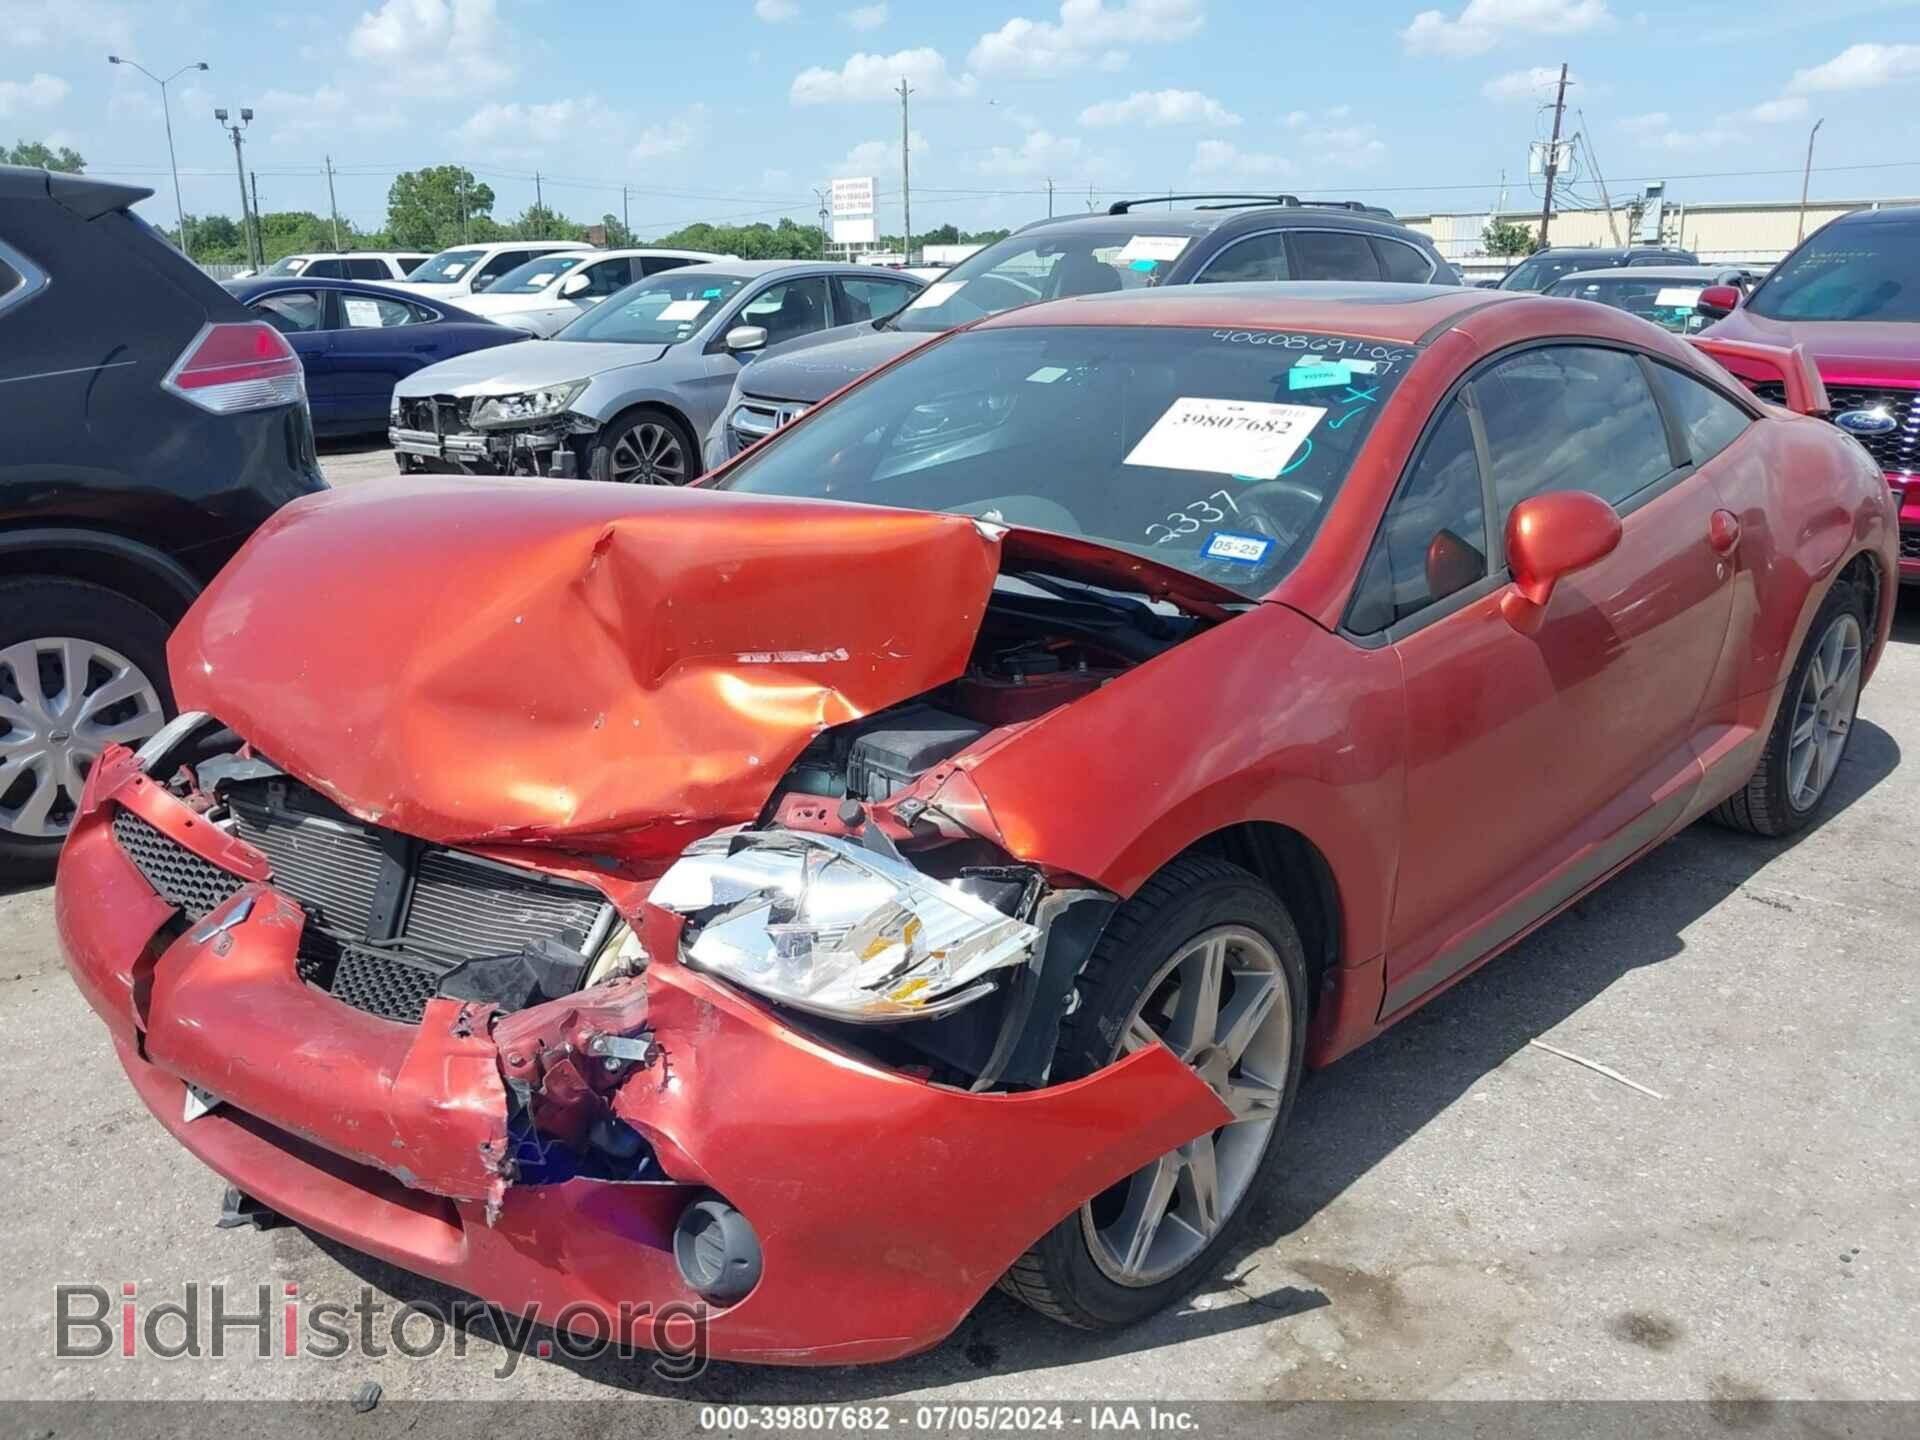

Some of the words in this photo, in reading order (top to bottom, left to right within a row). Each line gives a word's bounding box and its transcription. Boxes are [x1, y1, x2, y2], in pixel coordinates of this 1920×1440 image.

[1173, 412, 1293, 435] 39807682
[1145, 489, 1240, 544] 2337
[1213, 540, 1259, 556] 05-25
